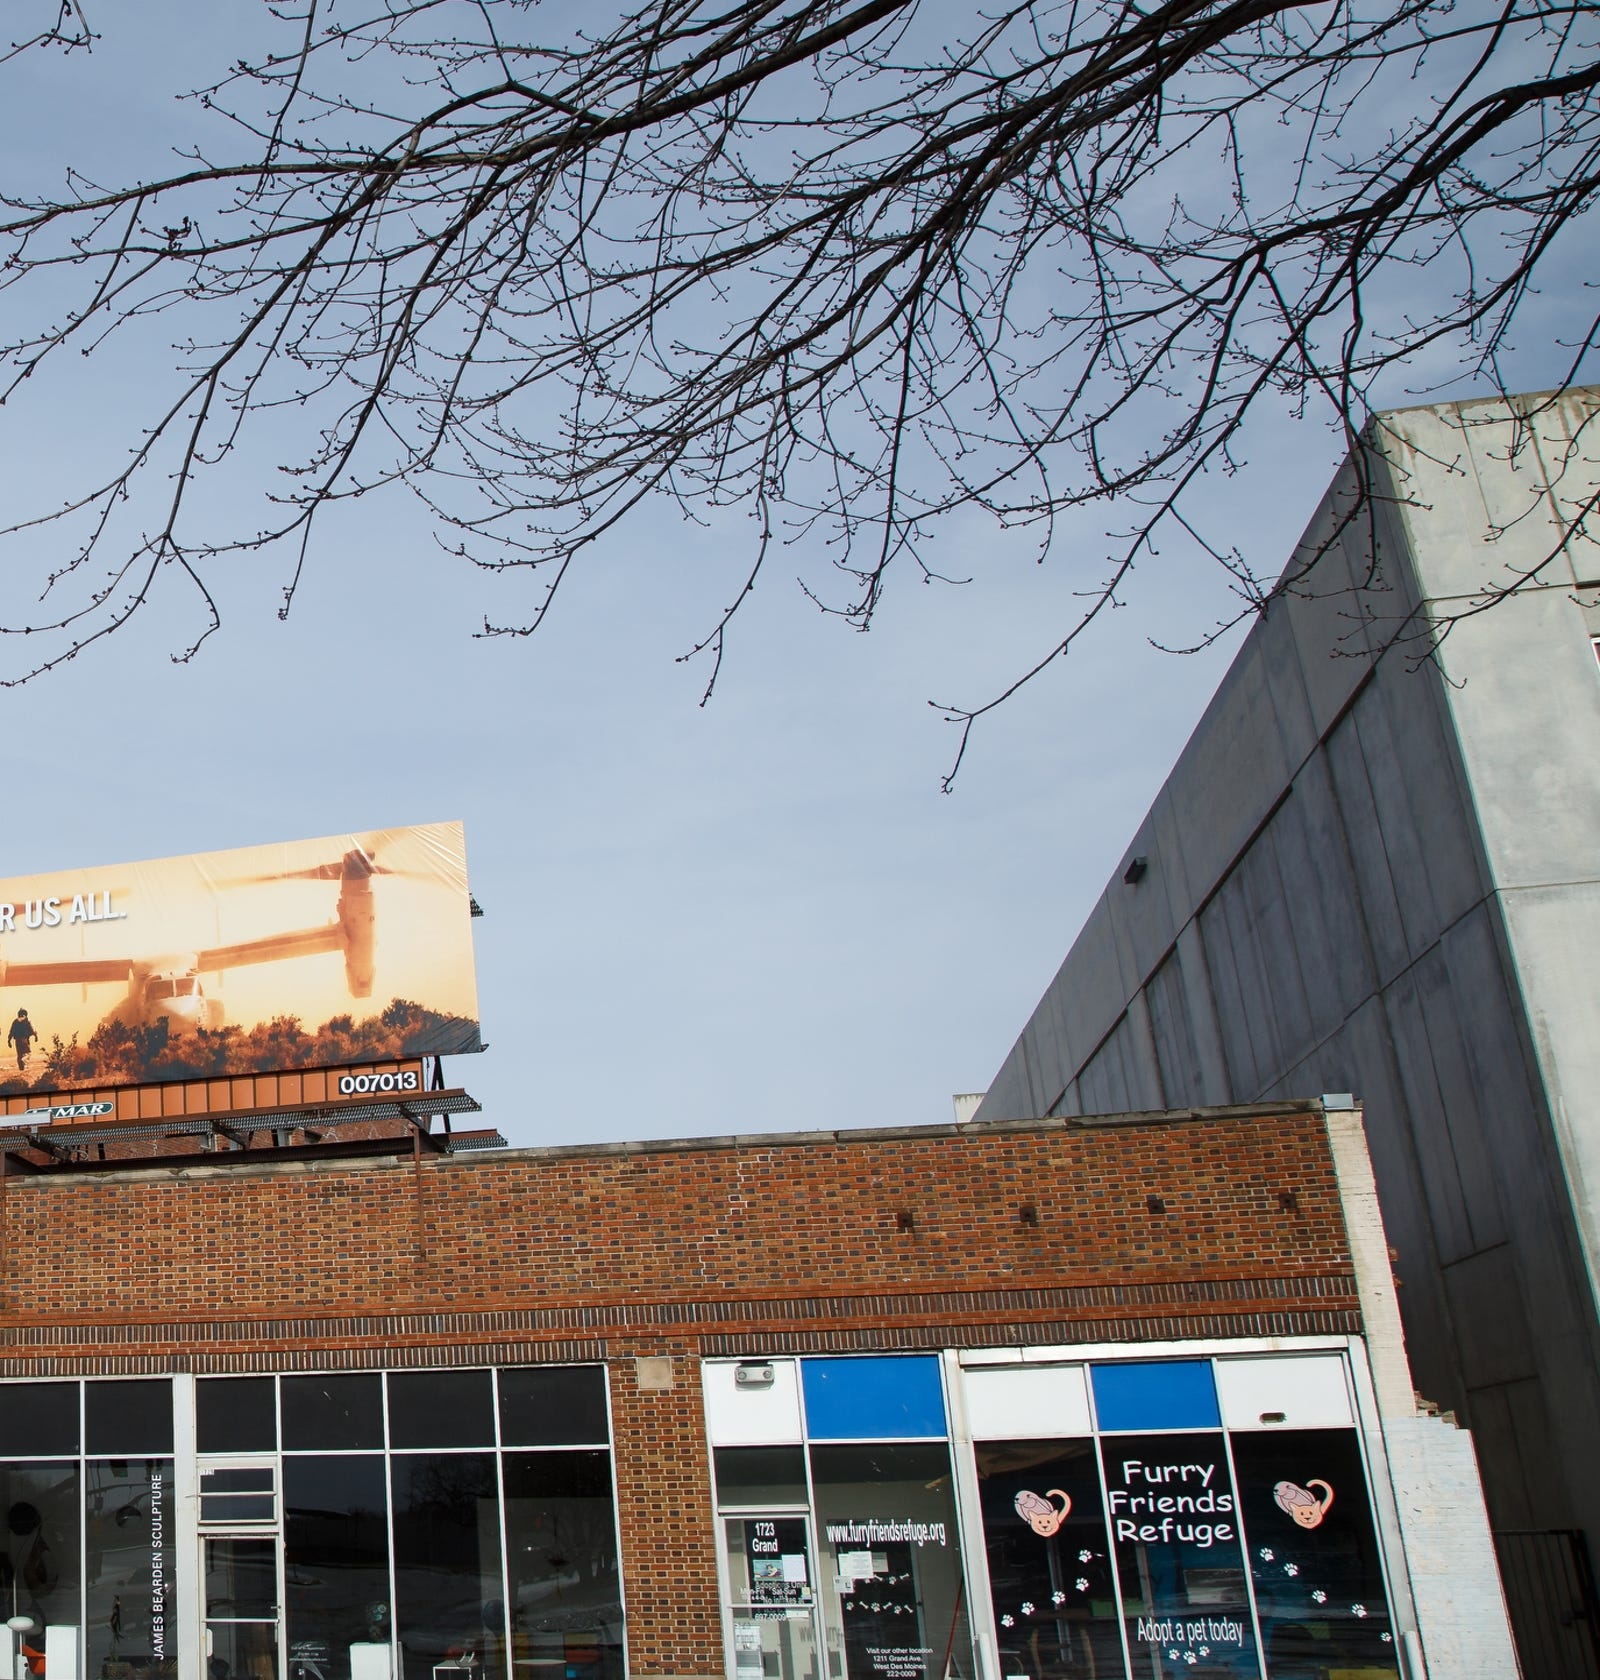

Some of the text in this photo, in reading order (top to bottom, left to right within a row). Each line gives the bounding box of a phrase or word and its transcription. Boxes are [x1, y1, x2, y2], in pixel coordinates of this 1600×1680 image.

[25, 897, 61, 928] US
[69, 891, 127, 923] ALL.
[340, 1072, 417, 1094] 007013
[32, 1104, 104, 1117] MAR
[1123, 1460, 1215, 1487] Furry
[1109, 1489, 1233, 1515] Friends
[755, 1522, 775, 1536] 1723
[826, 1518, 946, 1548] www.furryfriendsrefuge.org
[1116, 1518, 1234, 1547] Refuge
[752, 1538, 778, 1552] Grand
[152, 1474, 165, 1660] JAMES BEARDEN SCULPTURE
[1138, 1616, 1243, 1648] Adopt a pet today
